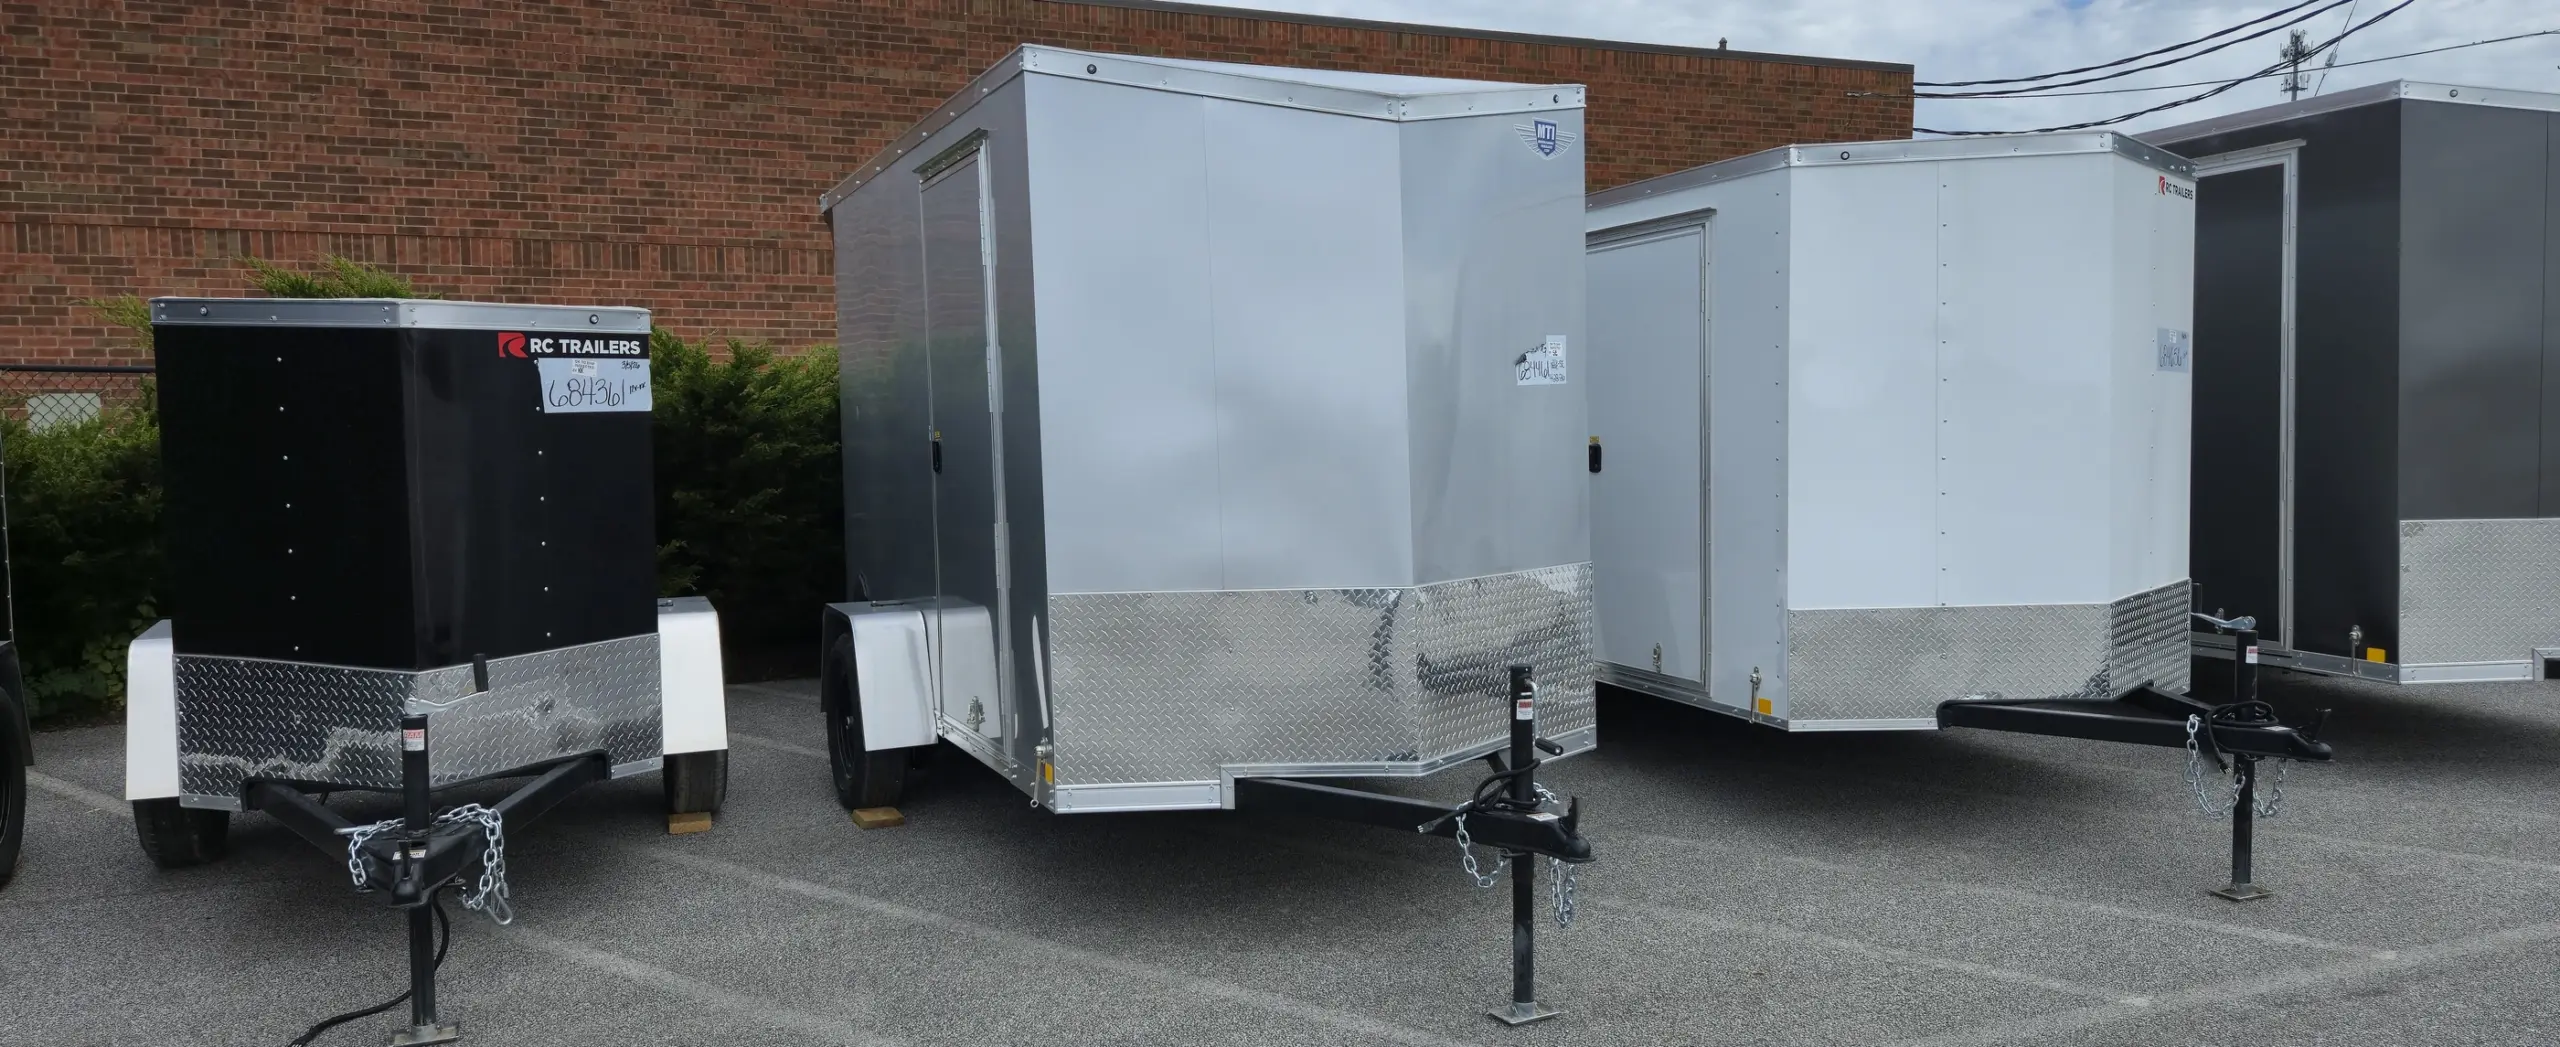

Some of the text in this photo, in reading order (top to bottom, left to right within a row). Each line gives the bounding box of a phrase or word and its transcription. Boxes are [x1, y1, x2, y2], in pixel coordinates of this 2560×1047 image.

[1537, 123, 1555, 140] MTI
[2173, 184, 2193, 200] TRAILERS
[530, 338, 641, 355] RC TRAILERS
[549, 377, 626, 407] 684361
